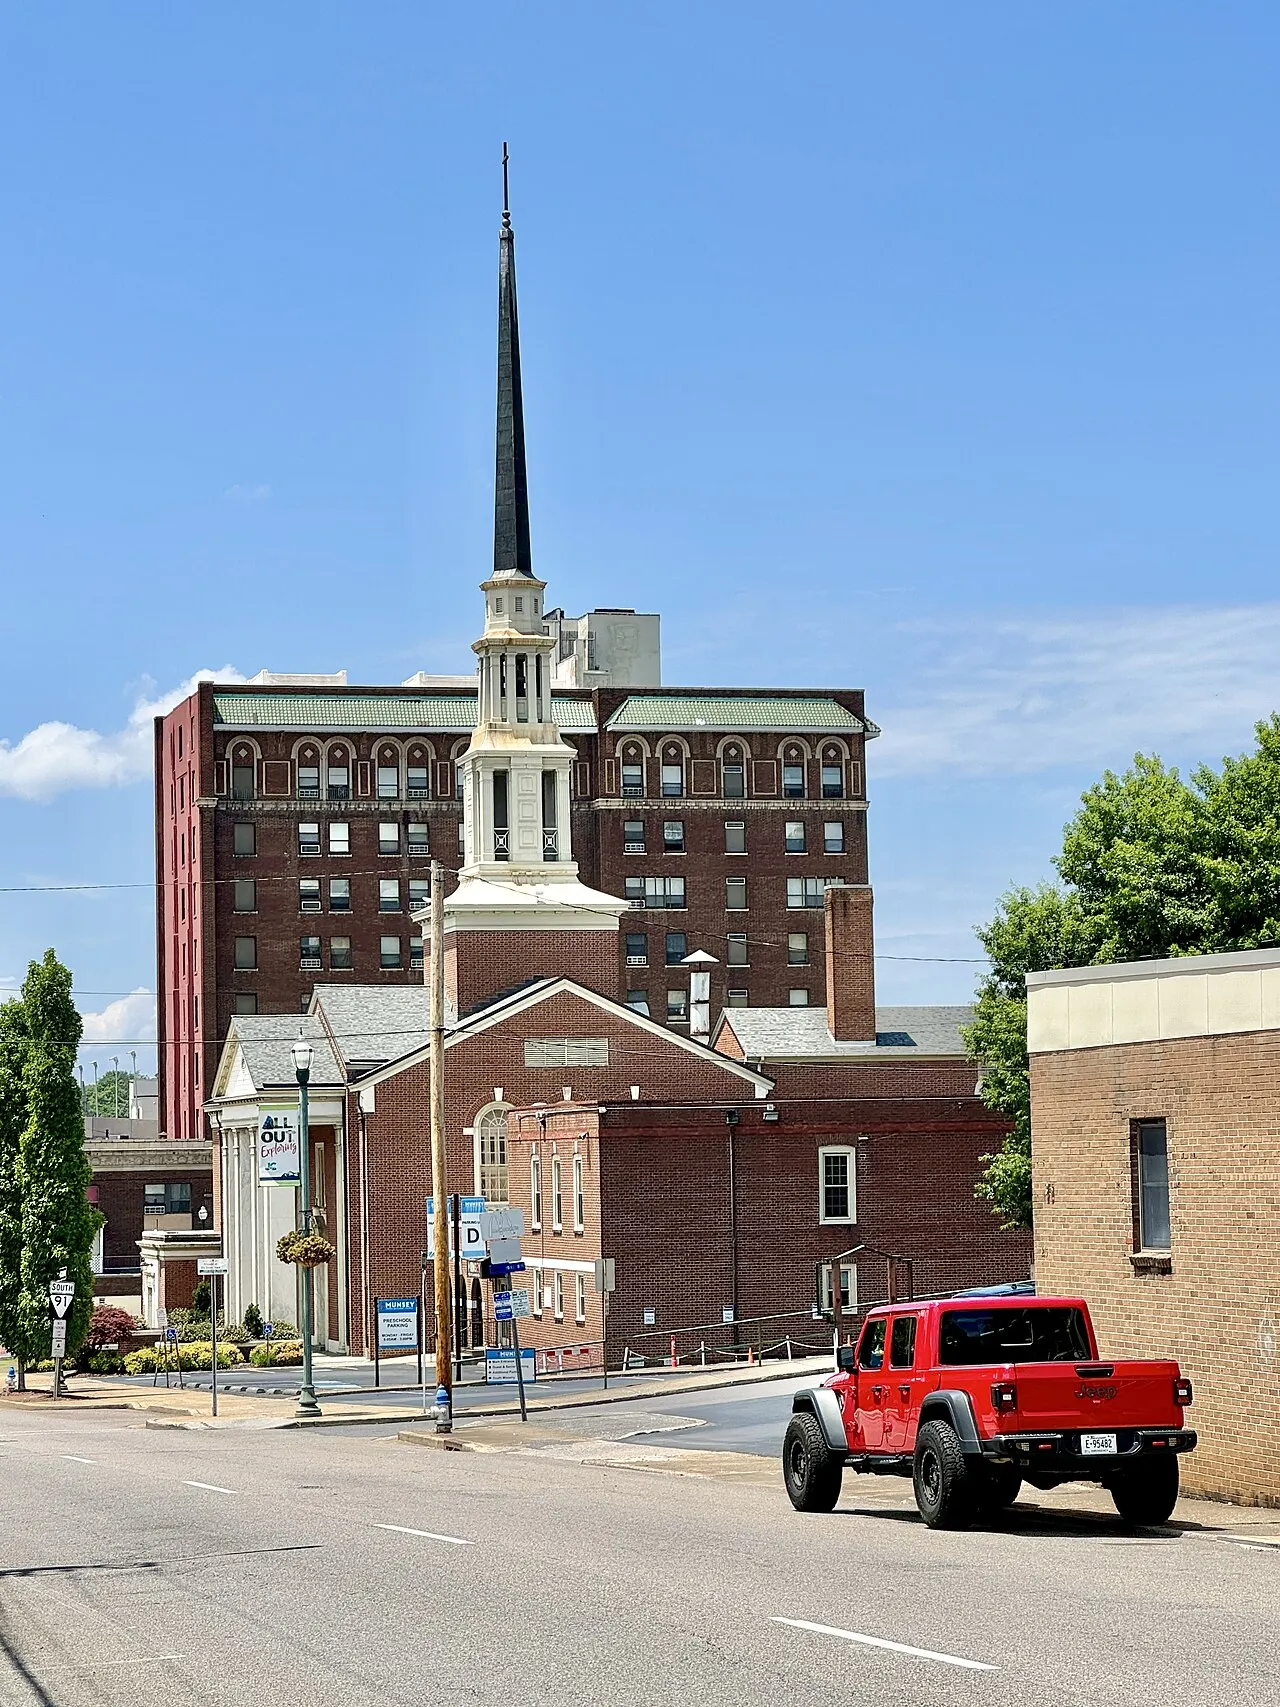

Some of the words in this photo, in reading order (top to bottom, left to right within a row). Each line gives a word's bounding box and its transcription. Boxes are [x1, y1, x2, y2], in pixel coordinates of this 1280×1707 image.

[262, 1115, 293, 1129] ALL
[261, 1130, 296, 1143] OUT
[261, 1143, 297, 1158] Exploring
[467, 1228, 480, 1243] D
[51, 1283, 73, 1292] SOUTH
[54, 1296, 67, 1307] 91
[1075, 1383, 1117, 1400] Jeep
[1085, 1439, 1113, 1449] E-95482
